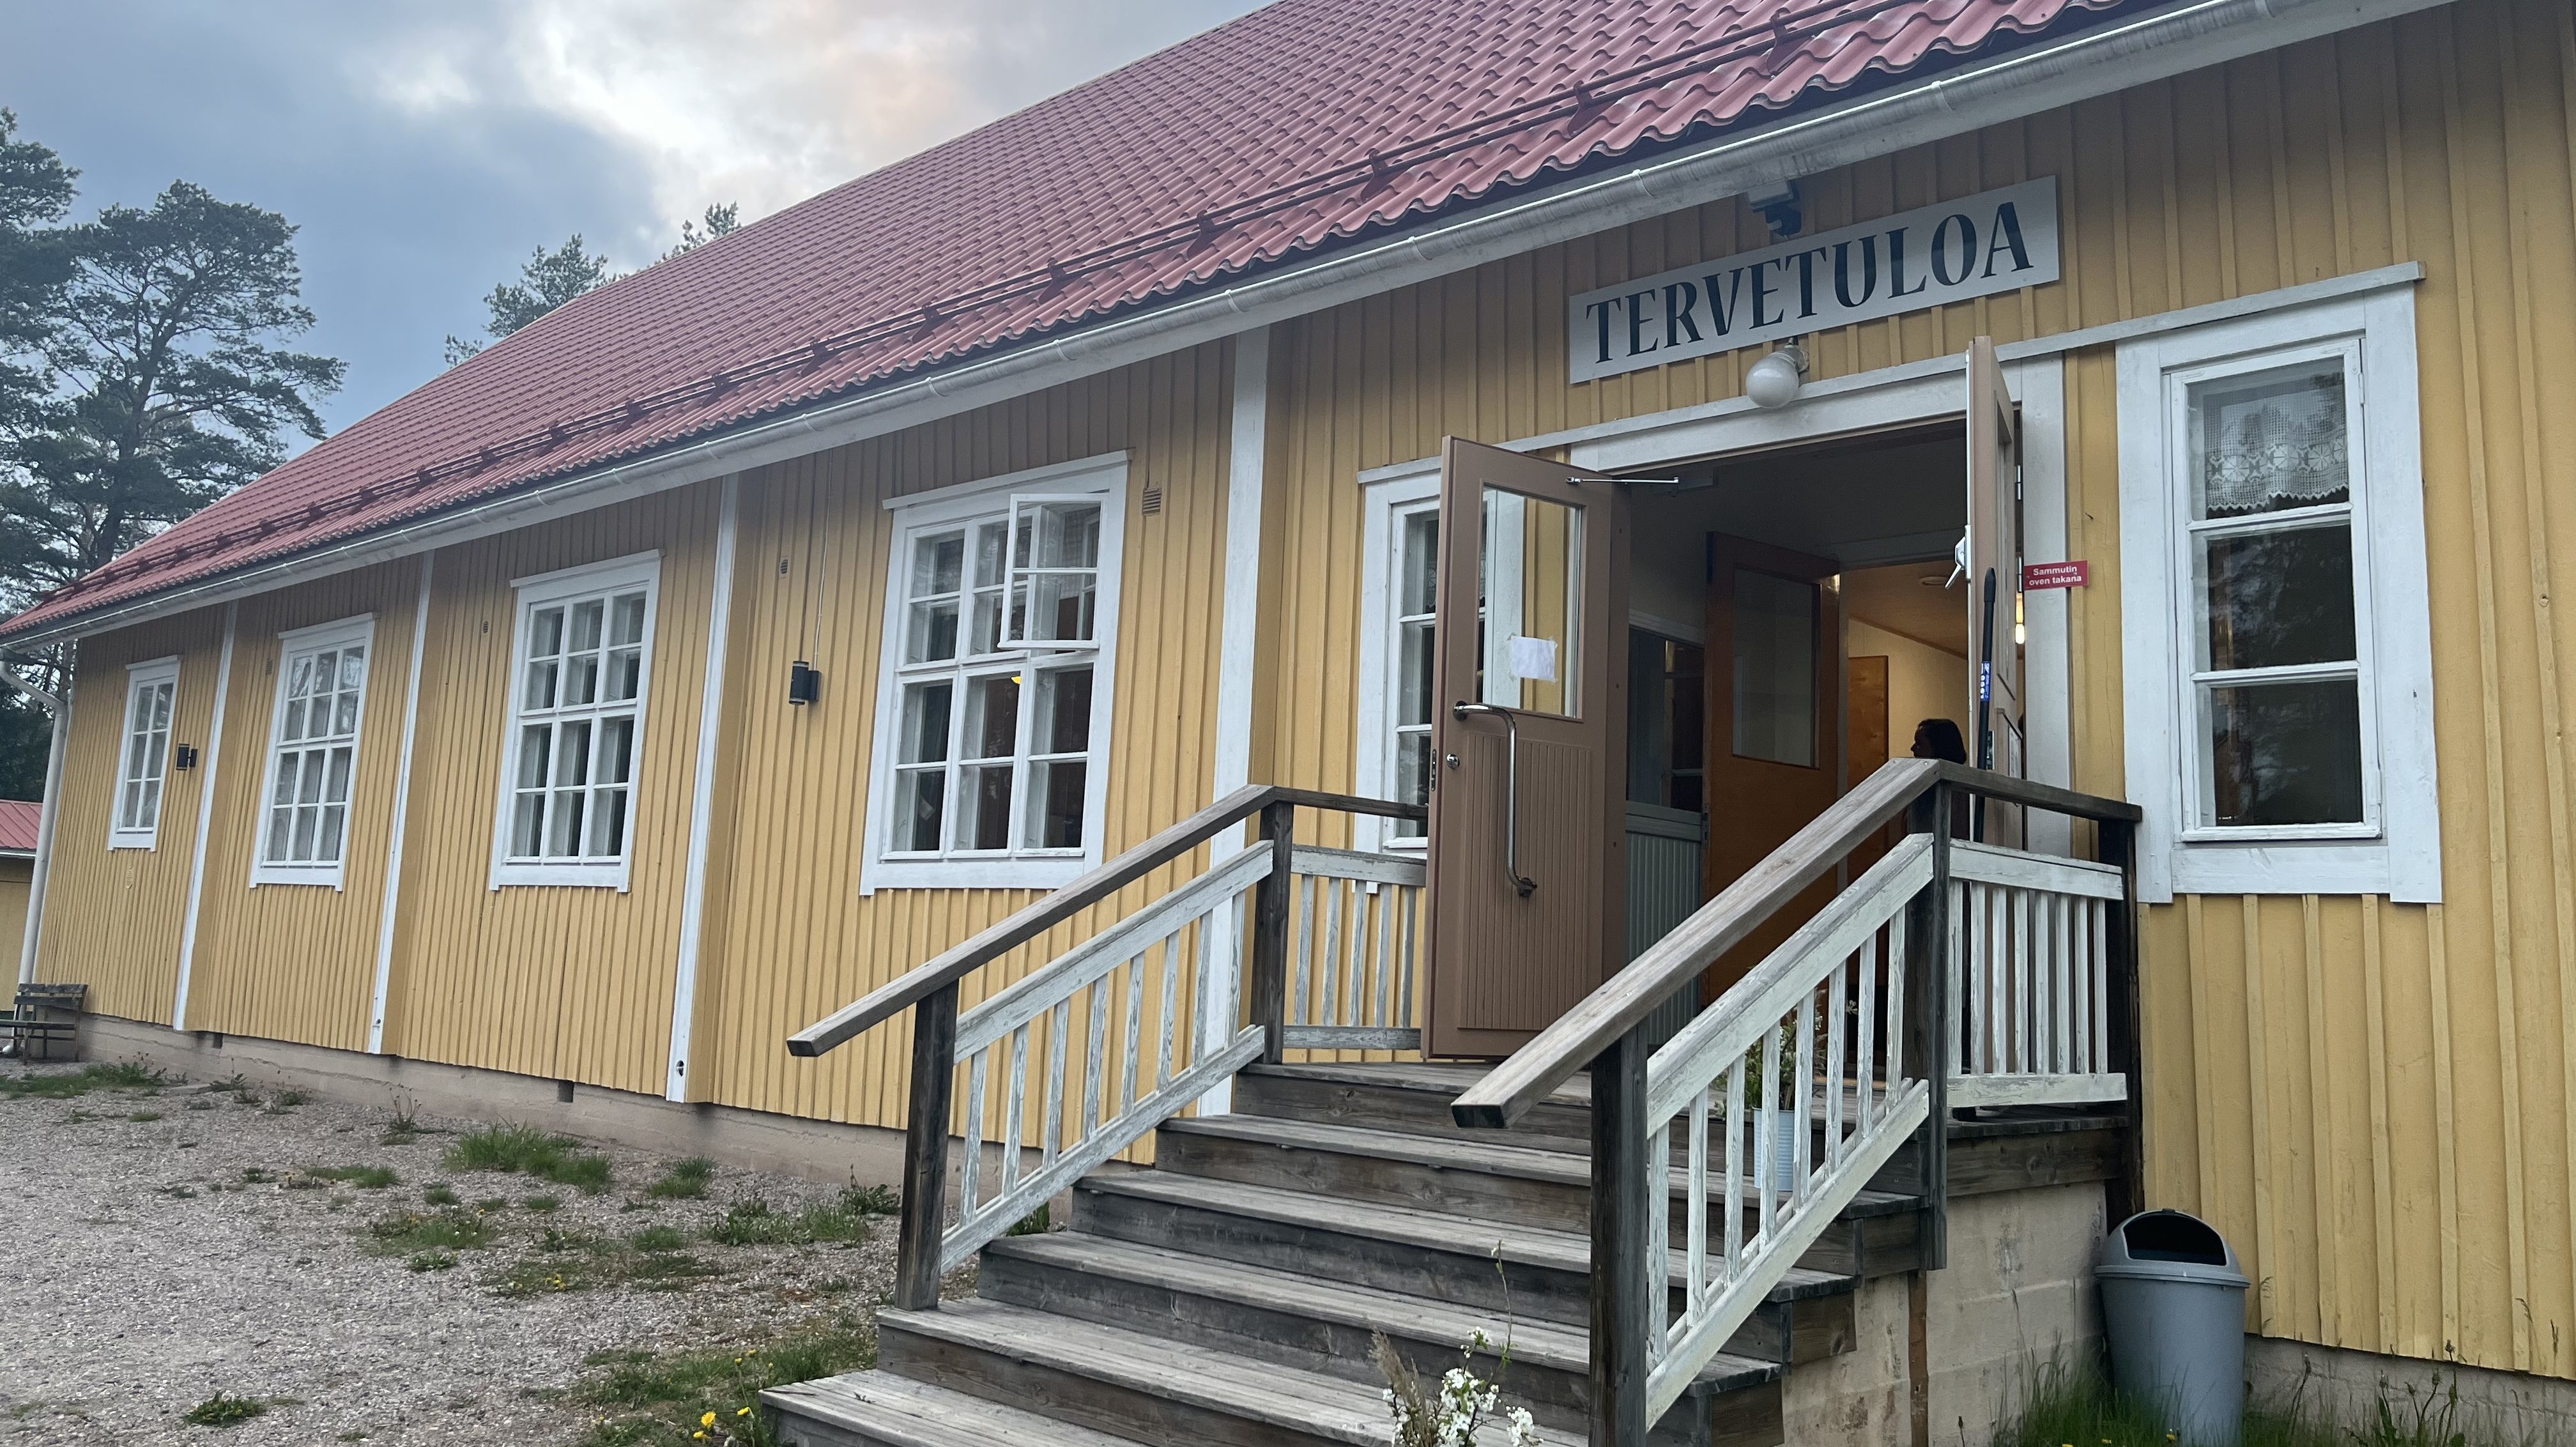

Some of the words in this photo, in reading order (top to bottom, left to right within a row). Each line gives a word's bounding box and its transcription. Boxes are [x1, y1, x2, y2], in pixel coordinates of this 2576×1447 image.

[1586, 202, 2034, 364] TERVETULOA
[2033, 565, 2077, 576] Sammutin
[2052, 576, 2082, 584] takana
